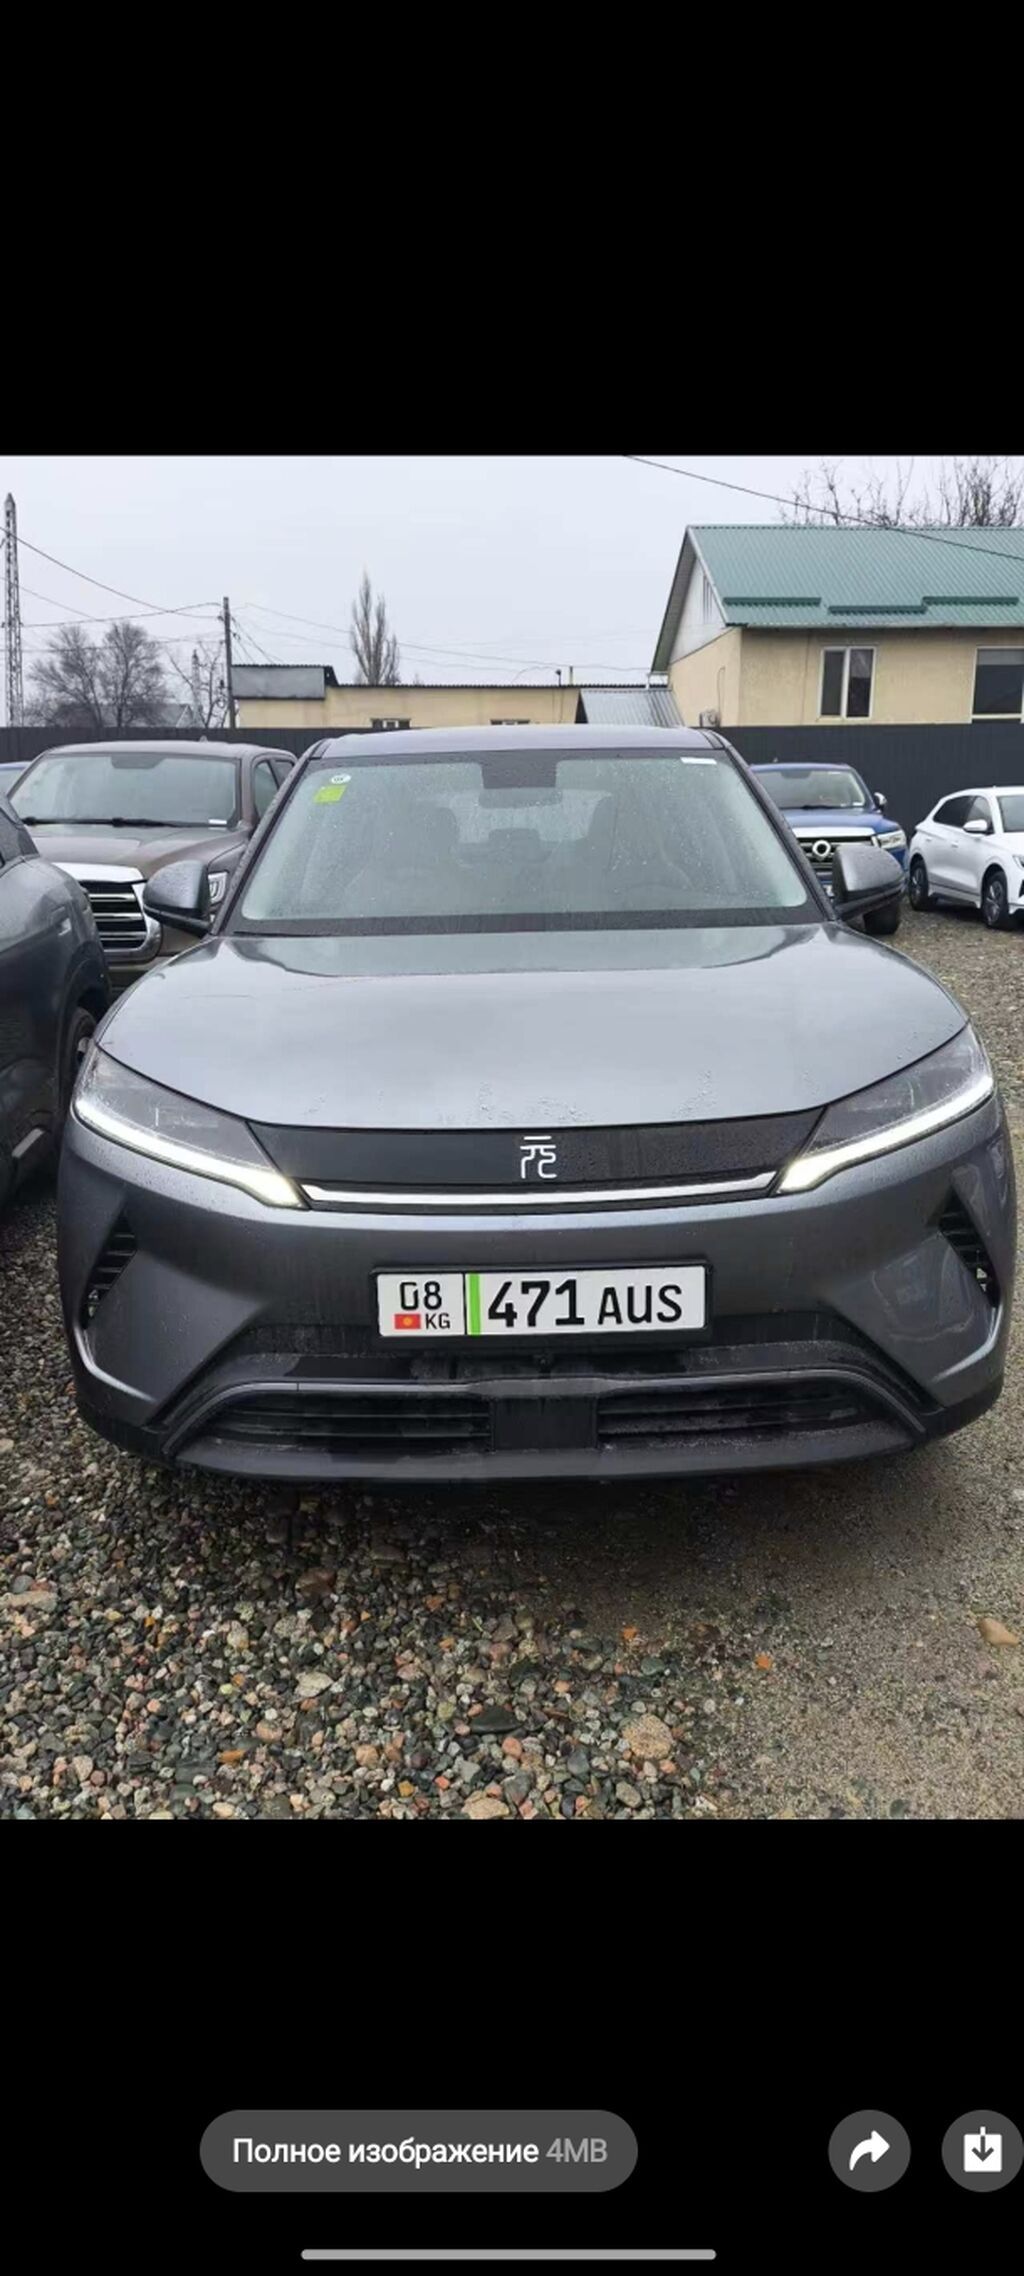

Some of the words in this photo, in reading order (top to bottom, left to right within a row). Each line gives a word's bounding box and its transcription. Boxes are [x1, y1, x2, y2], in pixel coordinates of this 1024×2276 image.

[400, 1281, 442, 1311] 08
[488, 1279, 585, 1327] 471
[598, 1285, 682, 1325] AUS
[425, 1313, 450, 1329] KG
